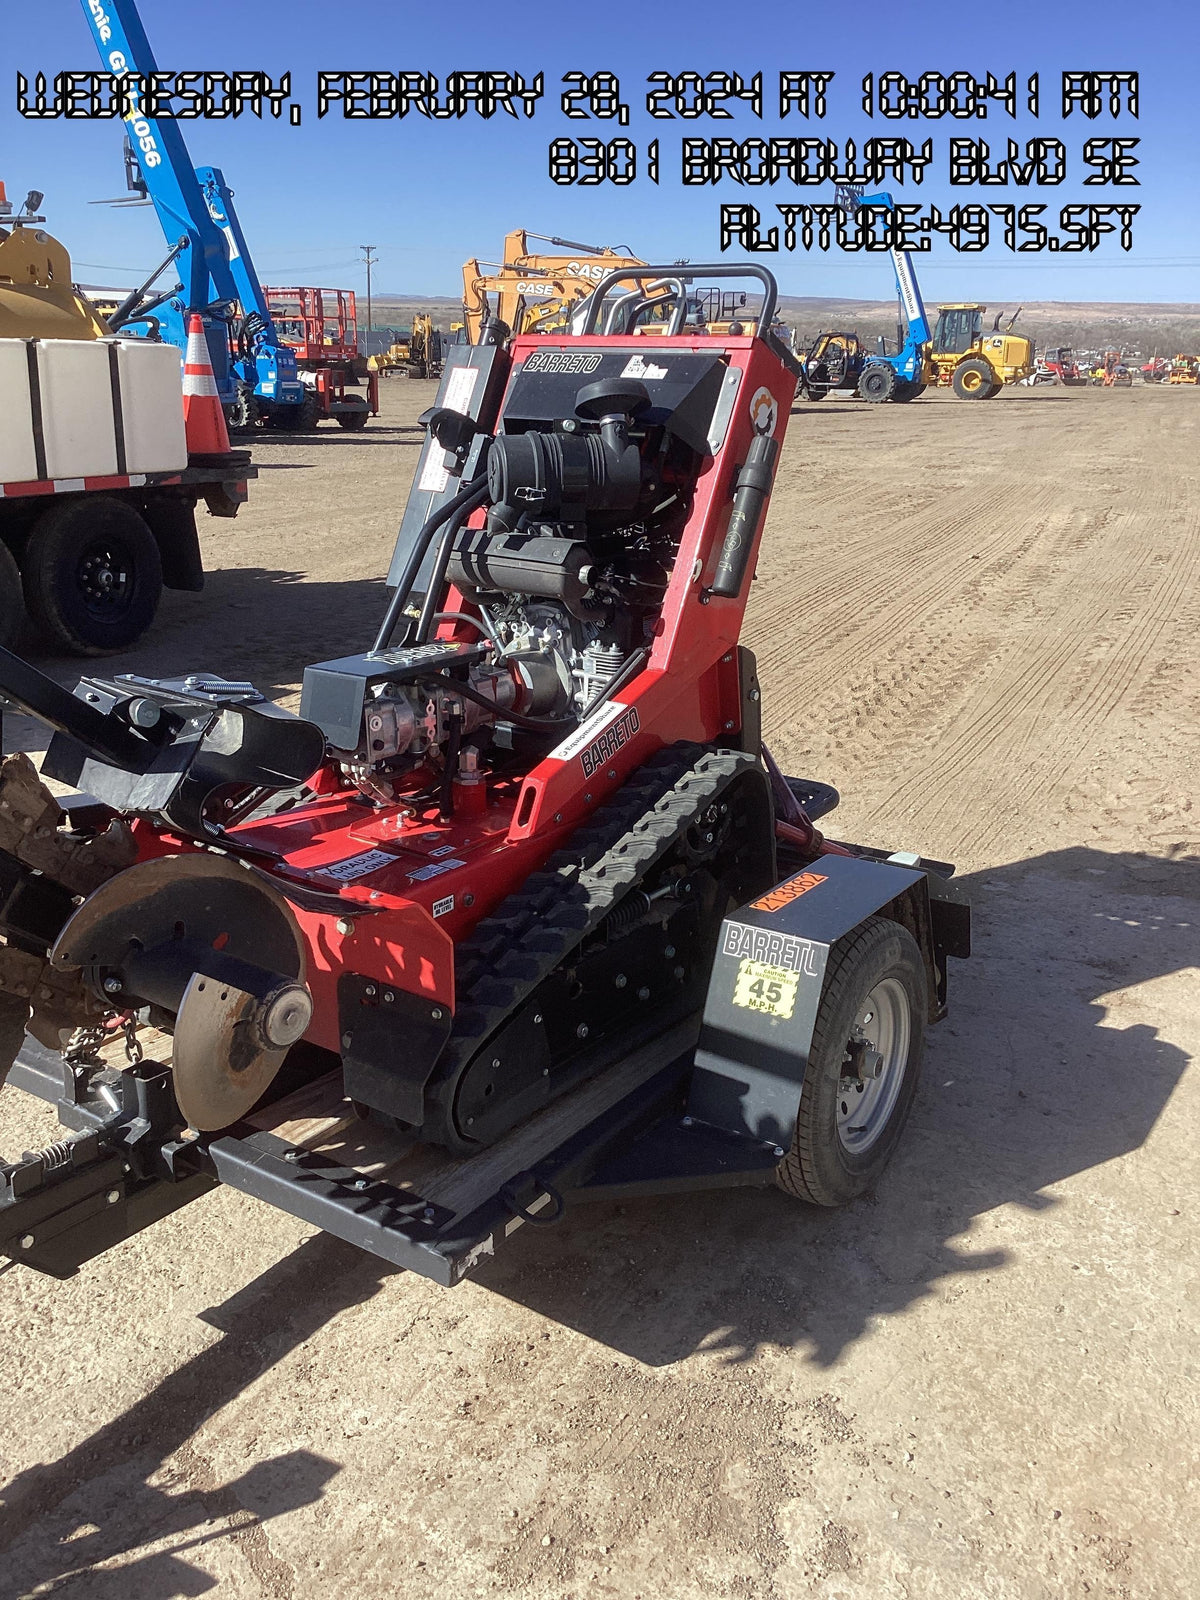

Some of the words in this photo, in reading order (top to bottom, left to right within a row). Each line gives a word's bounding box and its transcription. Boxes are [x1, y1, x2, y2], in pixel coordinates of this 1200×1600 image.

[88, 0, 111, 42] enie
[516, 281, 554, 296] CASE
[522, 352, 603, 374] BARRETO
[565, 706, 616, 751] EquipmentShare
[580, 706, 640, 780] BARRETO
[324, 852, 382, 876] YDRAULIC
[753, 873, 825, 911] 213862
[763, 968, 787, 979] CAUTION
[748, 979, 782, 1003] 45
[748, 998, 777, 1013] M.P.H.
